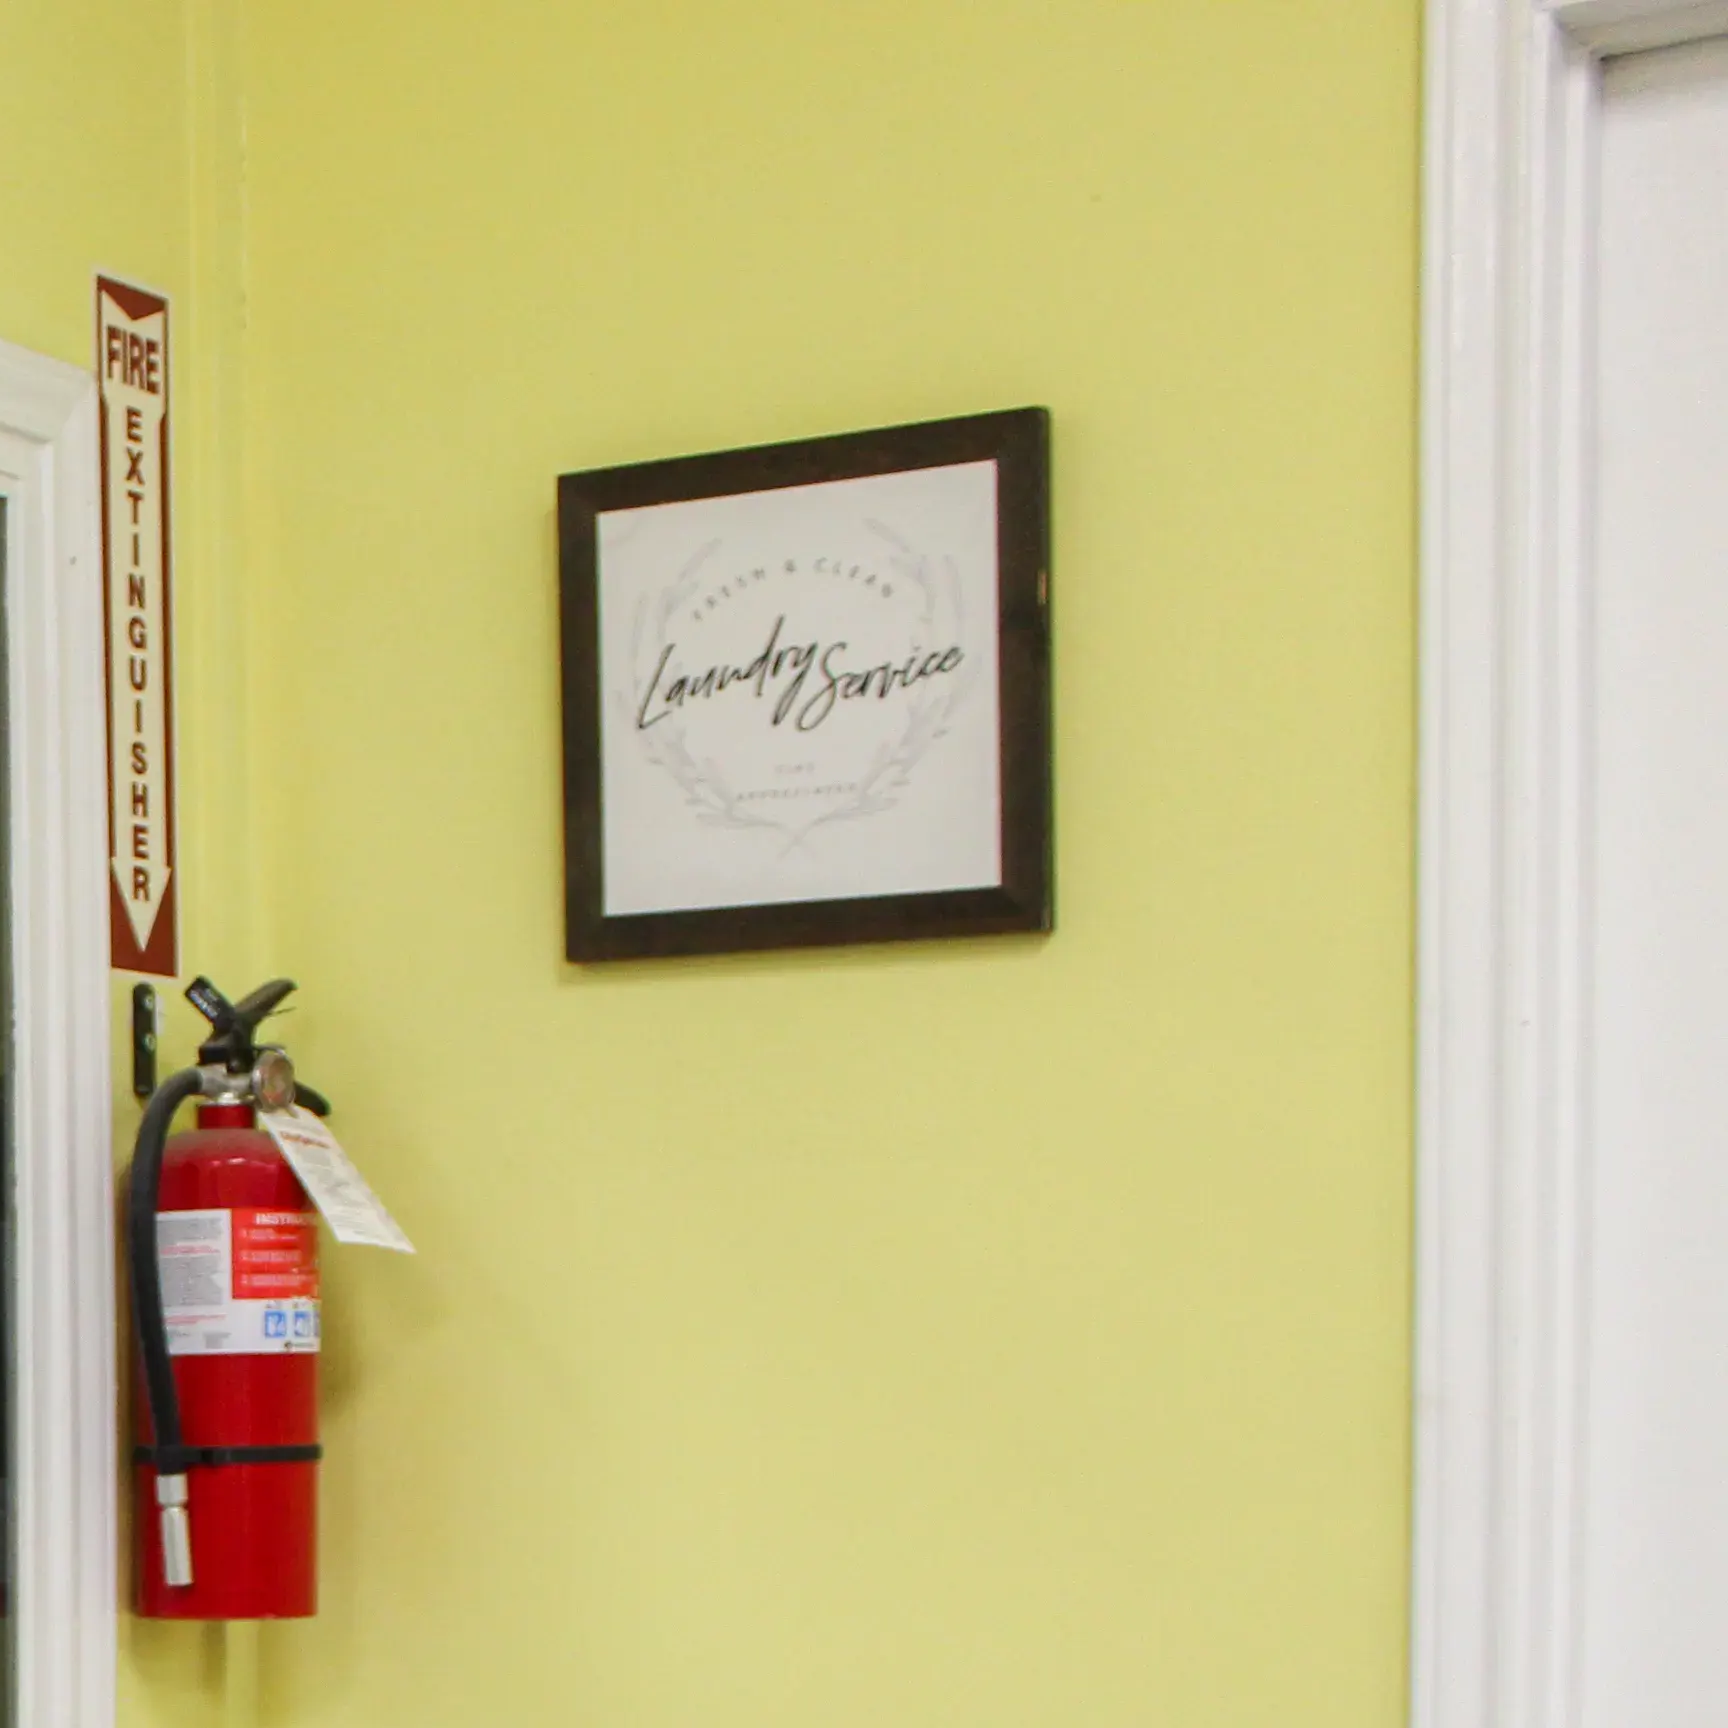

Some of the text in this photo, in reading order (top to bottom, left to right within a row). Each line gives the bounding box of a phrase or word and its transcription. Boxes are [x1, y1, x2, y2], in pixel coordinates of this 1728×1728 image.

[106, 326, 161, 396] FIRE
[123, 406, 152, 903] EXTINGUISHER
[637, 613, 965, 732] Laundry Service
